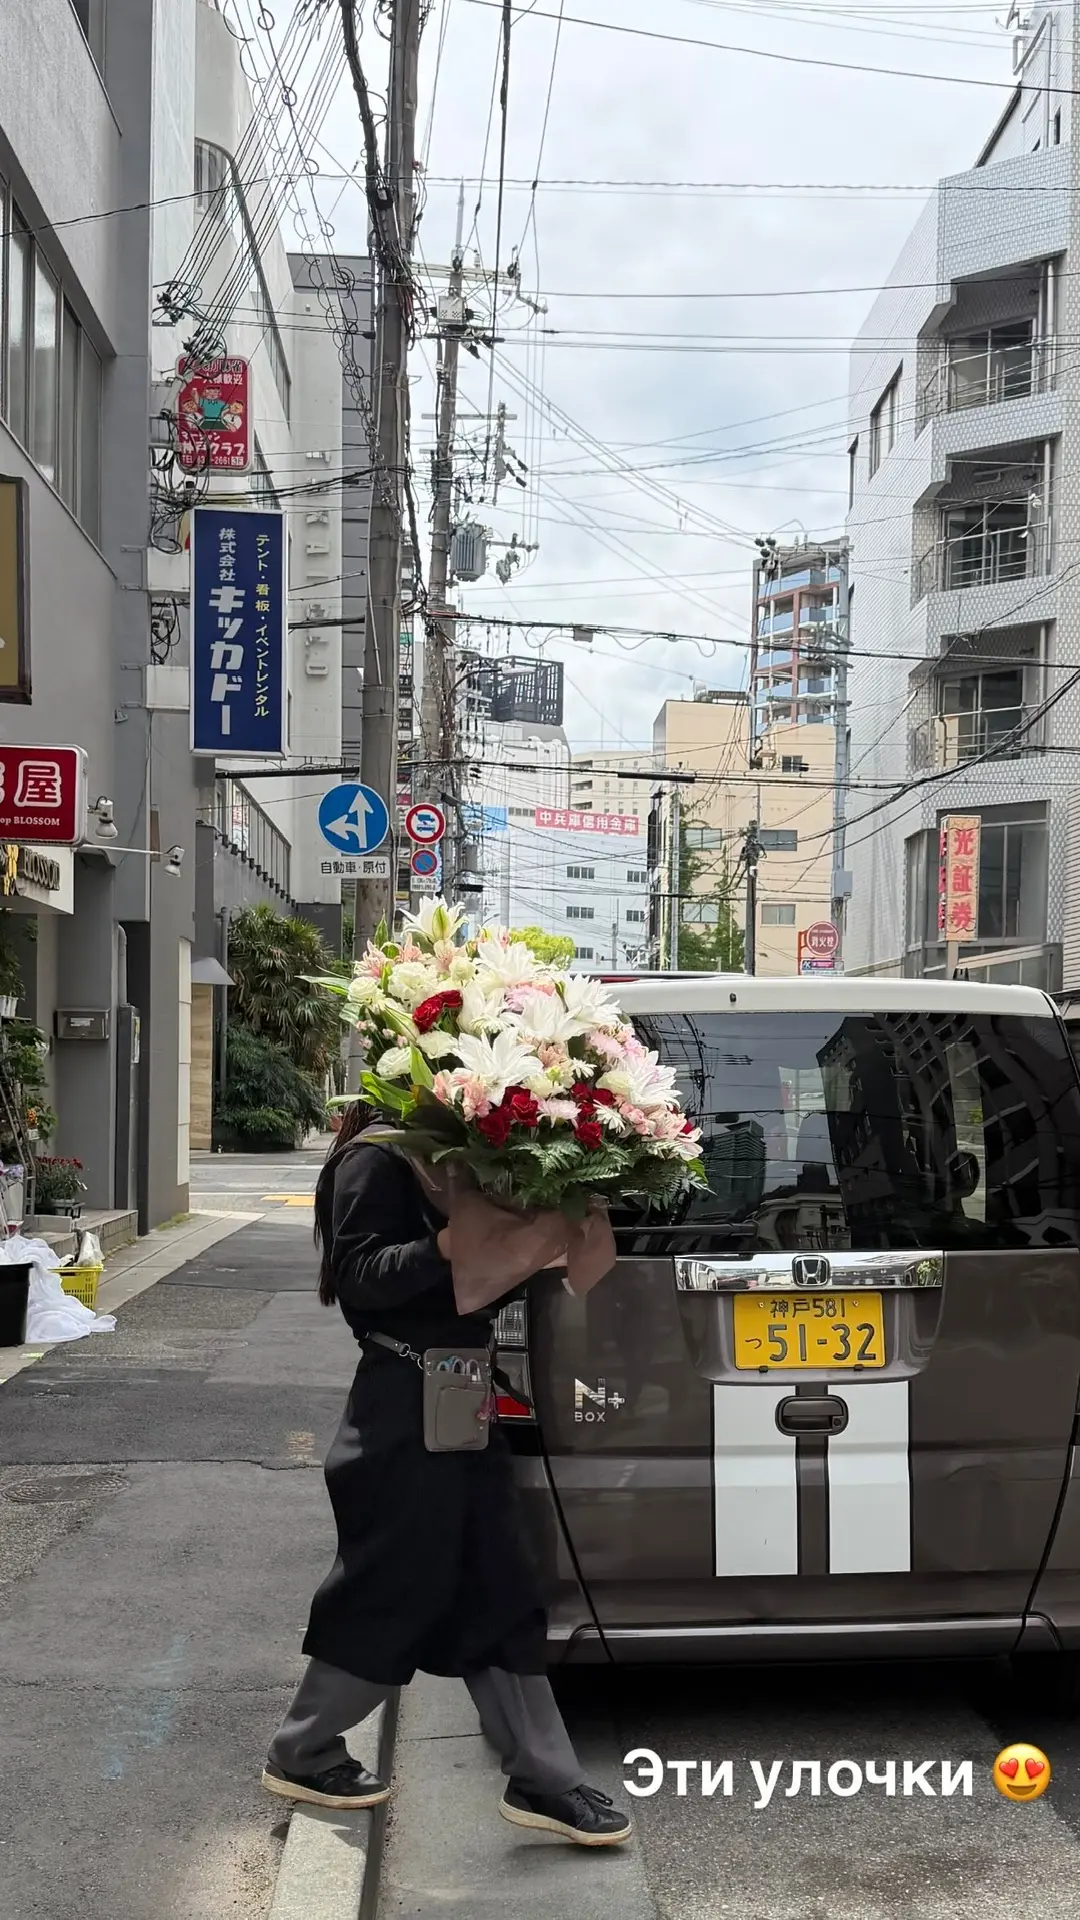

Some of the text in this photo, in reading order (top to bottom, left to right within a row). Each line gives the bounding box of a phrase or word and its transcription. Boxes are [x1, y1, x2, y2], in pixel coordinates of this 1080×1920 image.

[208, 528, 246, 736] 株式会社 キッカドー
[253, 534, 271, 717] テント・看板・イベントレンタル
[0, 760, 62, 808] 屋
[14, 816, 61, 826] BLOSSOM
[539, 809, 638, 832] 中兵庫信用金庫
[320, 861, 387, 875] 自動車・原付
[951, 828, 977, 930] 光証券
[574, 1411, 606, 1423] BOX
